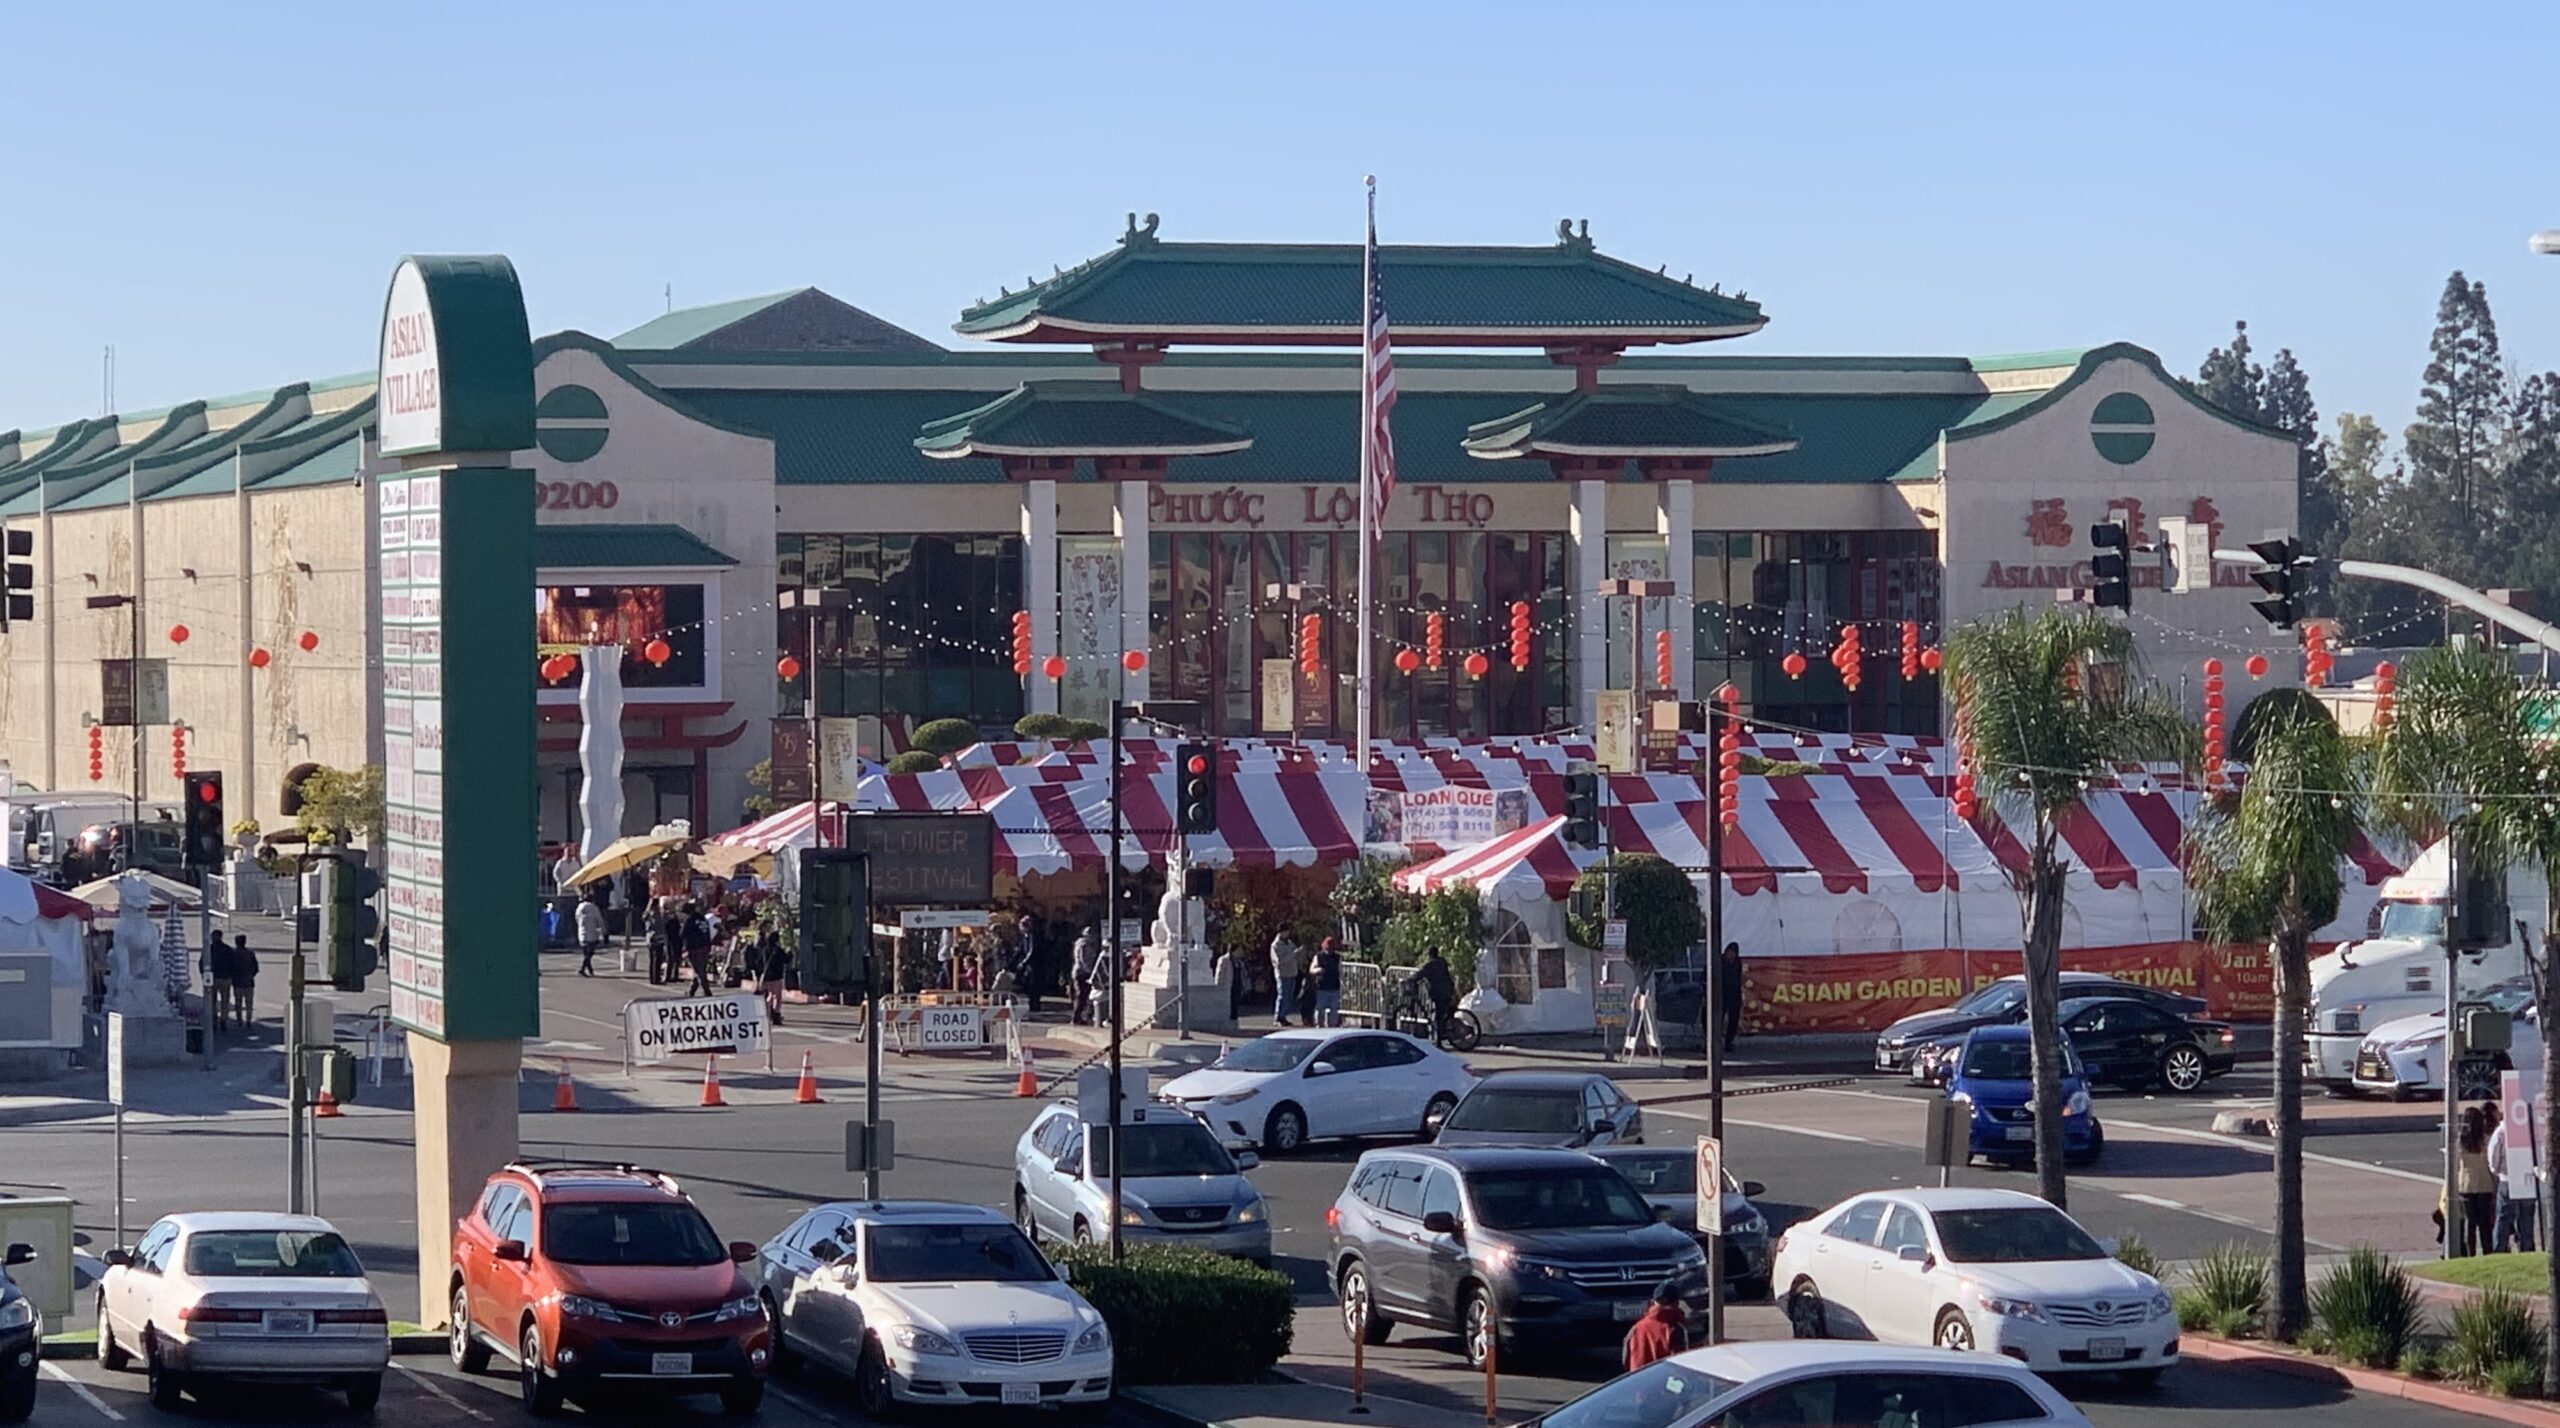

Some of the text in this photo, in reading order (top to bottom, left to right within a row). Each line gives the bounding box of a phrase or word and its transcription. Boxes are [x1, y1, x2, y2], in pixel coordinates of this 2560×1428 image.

[390, 311, 426, 359] ASIAN
[386, 368, 437, 416] VILLAGE
[1983, 561, 2070, 588] ASIAN
[1403, 790, 1451, 807] LOAN
[866, 829, 969, 853] FLOWER
[872, 867, 981, 889] ESTIVAL
[2222, 951, 2257, 969] Jan
[1772, 981, 1852, 1003] ASIAN
[1856, 977, 1962, 999] GARDEN
[658, 1002, 739, 1024] PARKING
[932, 1012, 970, 1026] ROAD
[639, 1021, 763, 1046] ON MORAN ST.
[924, 1029, 977, 1043] CLOSED
